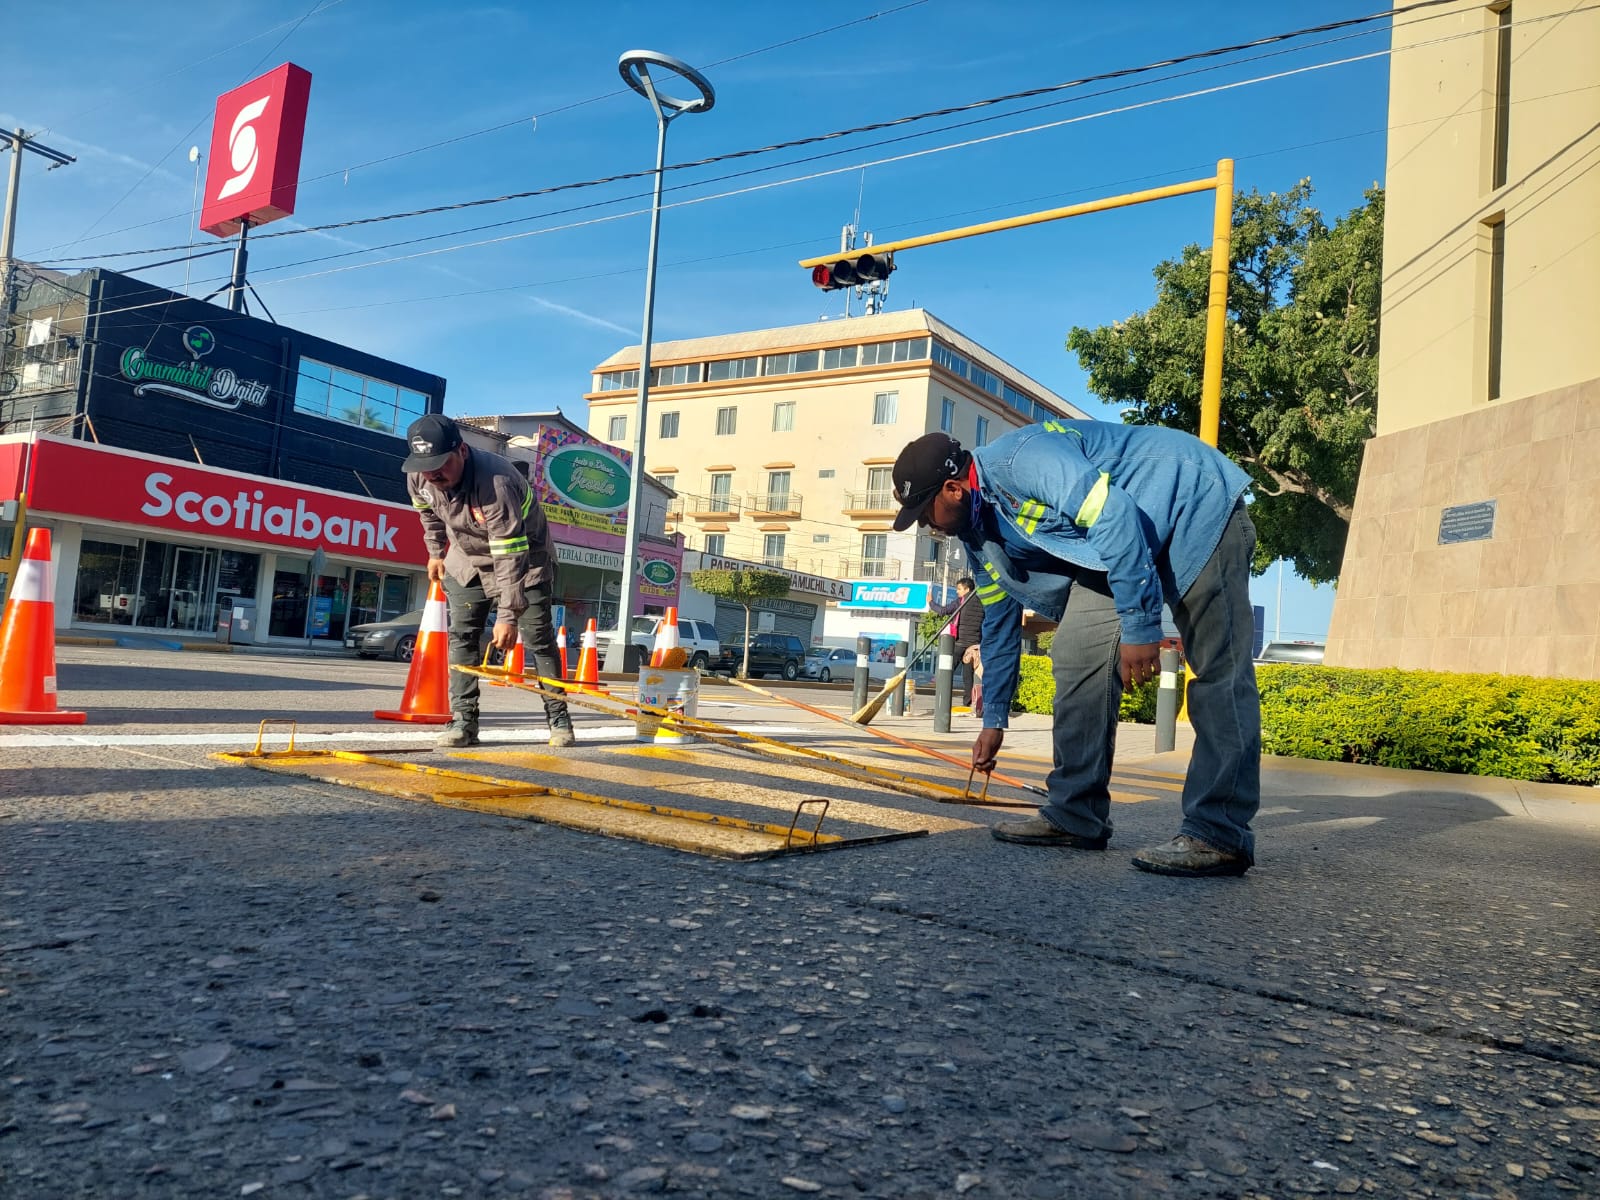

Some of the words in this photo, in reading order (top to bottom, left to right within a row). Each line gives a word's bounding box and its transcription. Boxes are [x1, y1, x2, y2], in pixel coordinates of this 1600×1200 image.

[121, 347, 213, 390] Guamúchil
[209, 368, 269, 406] Digital
[141, 472, 399, 552] Scotiabank
[558, 547, 583, 562] TERIAL
[584, 552, 619, 567] CREATIVO
